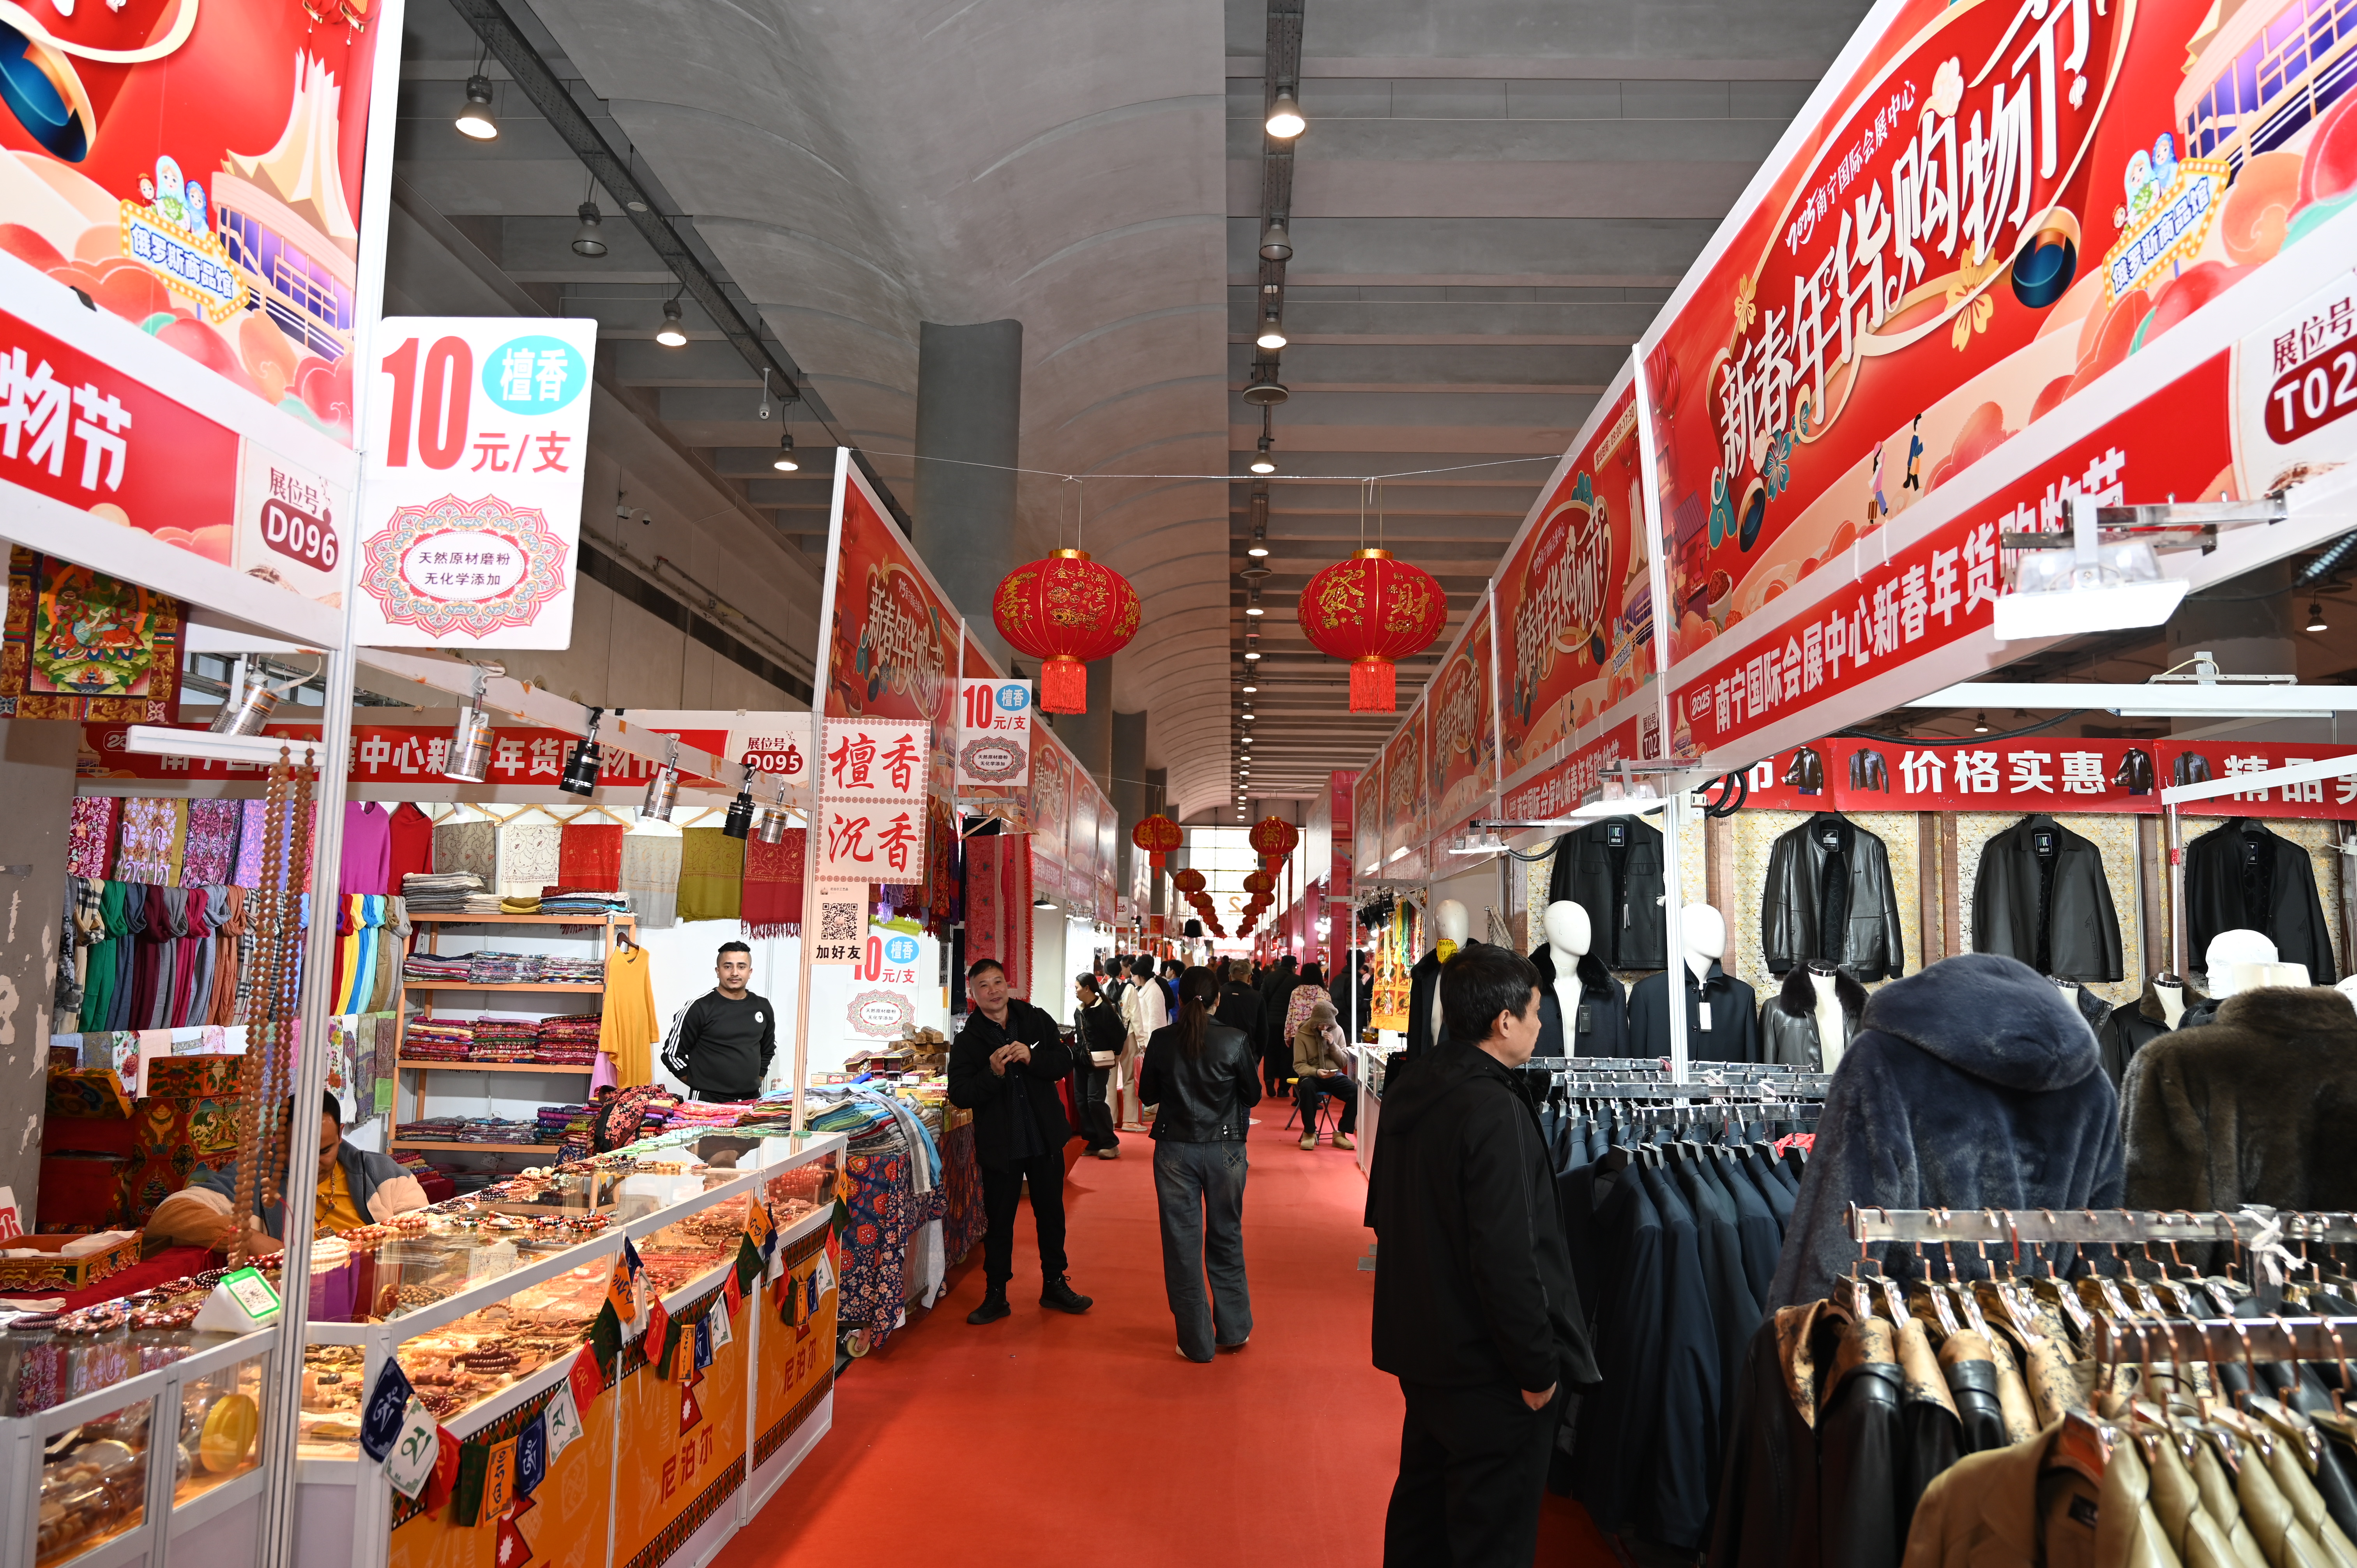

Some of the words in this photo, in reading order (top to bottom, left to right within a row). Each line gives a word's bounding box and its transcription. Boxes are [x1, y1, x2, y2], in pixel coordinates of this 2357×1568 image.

[1814, 80, 1916, 222] 南宁国际会展中心
[2111, 175, 2210, 294] 俄罗斯商品馆
[131, 223, 233, 299] 俄罗斯商品馆
[2272, 296, 2355, 377] 展位号
[500, 348, 568, 401] 檀香
[0, 346, 132, 493] 物节
[382, 335, 473, 470] 10
[471, 431, 571, 473] 元/支
[269, 467, 319, 516] 展位号
[267, 505, 336, 567] D096
[419, 551, 511, 565] 天然原材磨粉
[1540, 522, 1565, 567] 南宁国际会展中心
[424, 572, 501, 586] 无化学添加
[905, 586, 924, 619] 南宁国际会展中心
[1516, 502, 1605, 682] 新春年货购物节
[863, 576, 945, 713] 新春年货购物节
[963, 684, 993, 729] 10
[994, 716, 1026, 730] 元/支
[1002, 689, 1024, 707] 檀香
[1643, 712, 1656, 733] 展位号
[746, 754, 799, 770] D095
[747, 737, 786, 751] 展位号
[827, 733, 921, 793] 檀香
[1899, 750, 2105, 794] 价格实惠
[828, 812, 917, 873] 沉香
[816, 945, 861, 961] 加好友
[891, 940, 913, 959] 檀香
[882, 969, 915, 984] 元/支
[784, 1337, 817, 1395] 尼泊尔
[661, 1423, 714, 1504] 尼泊尔
